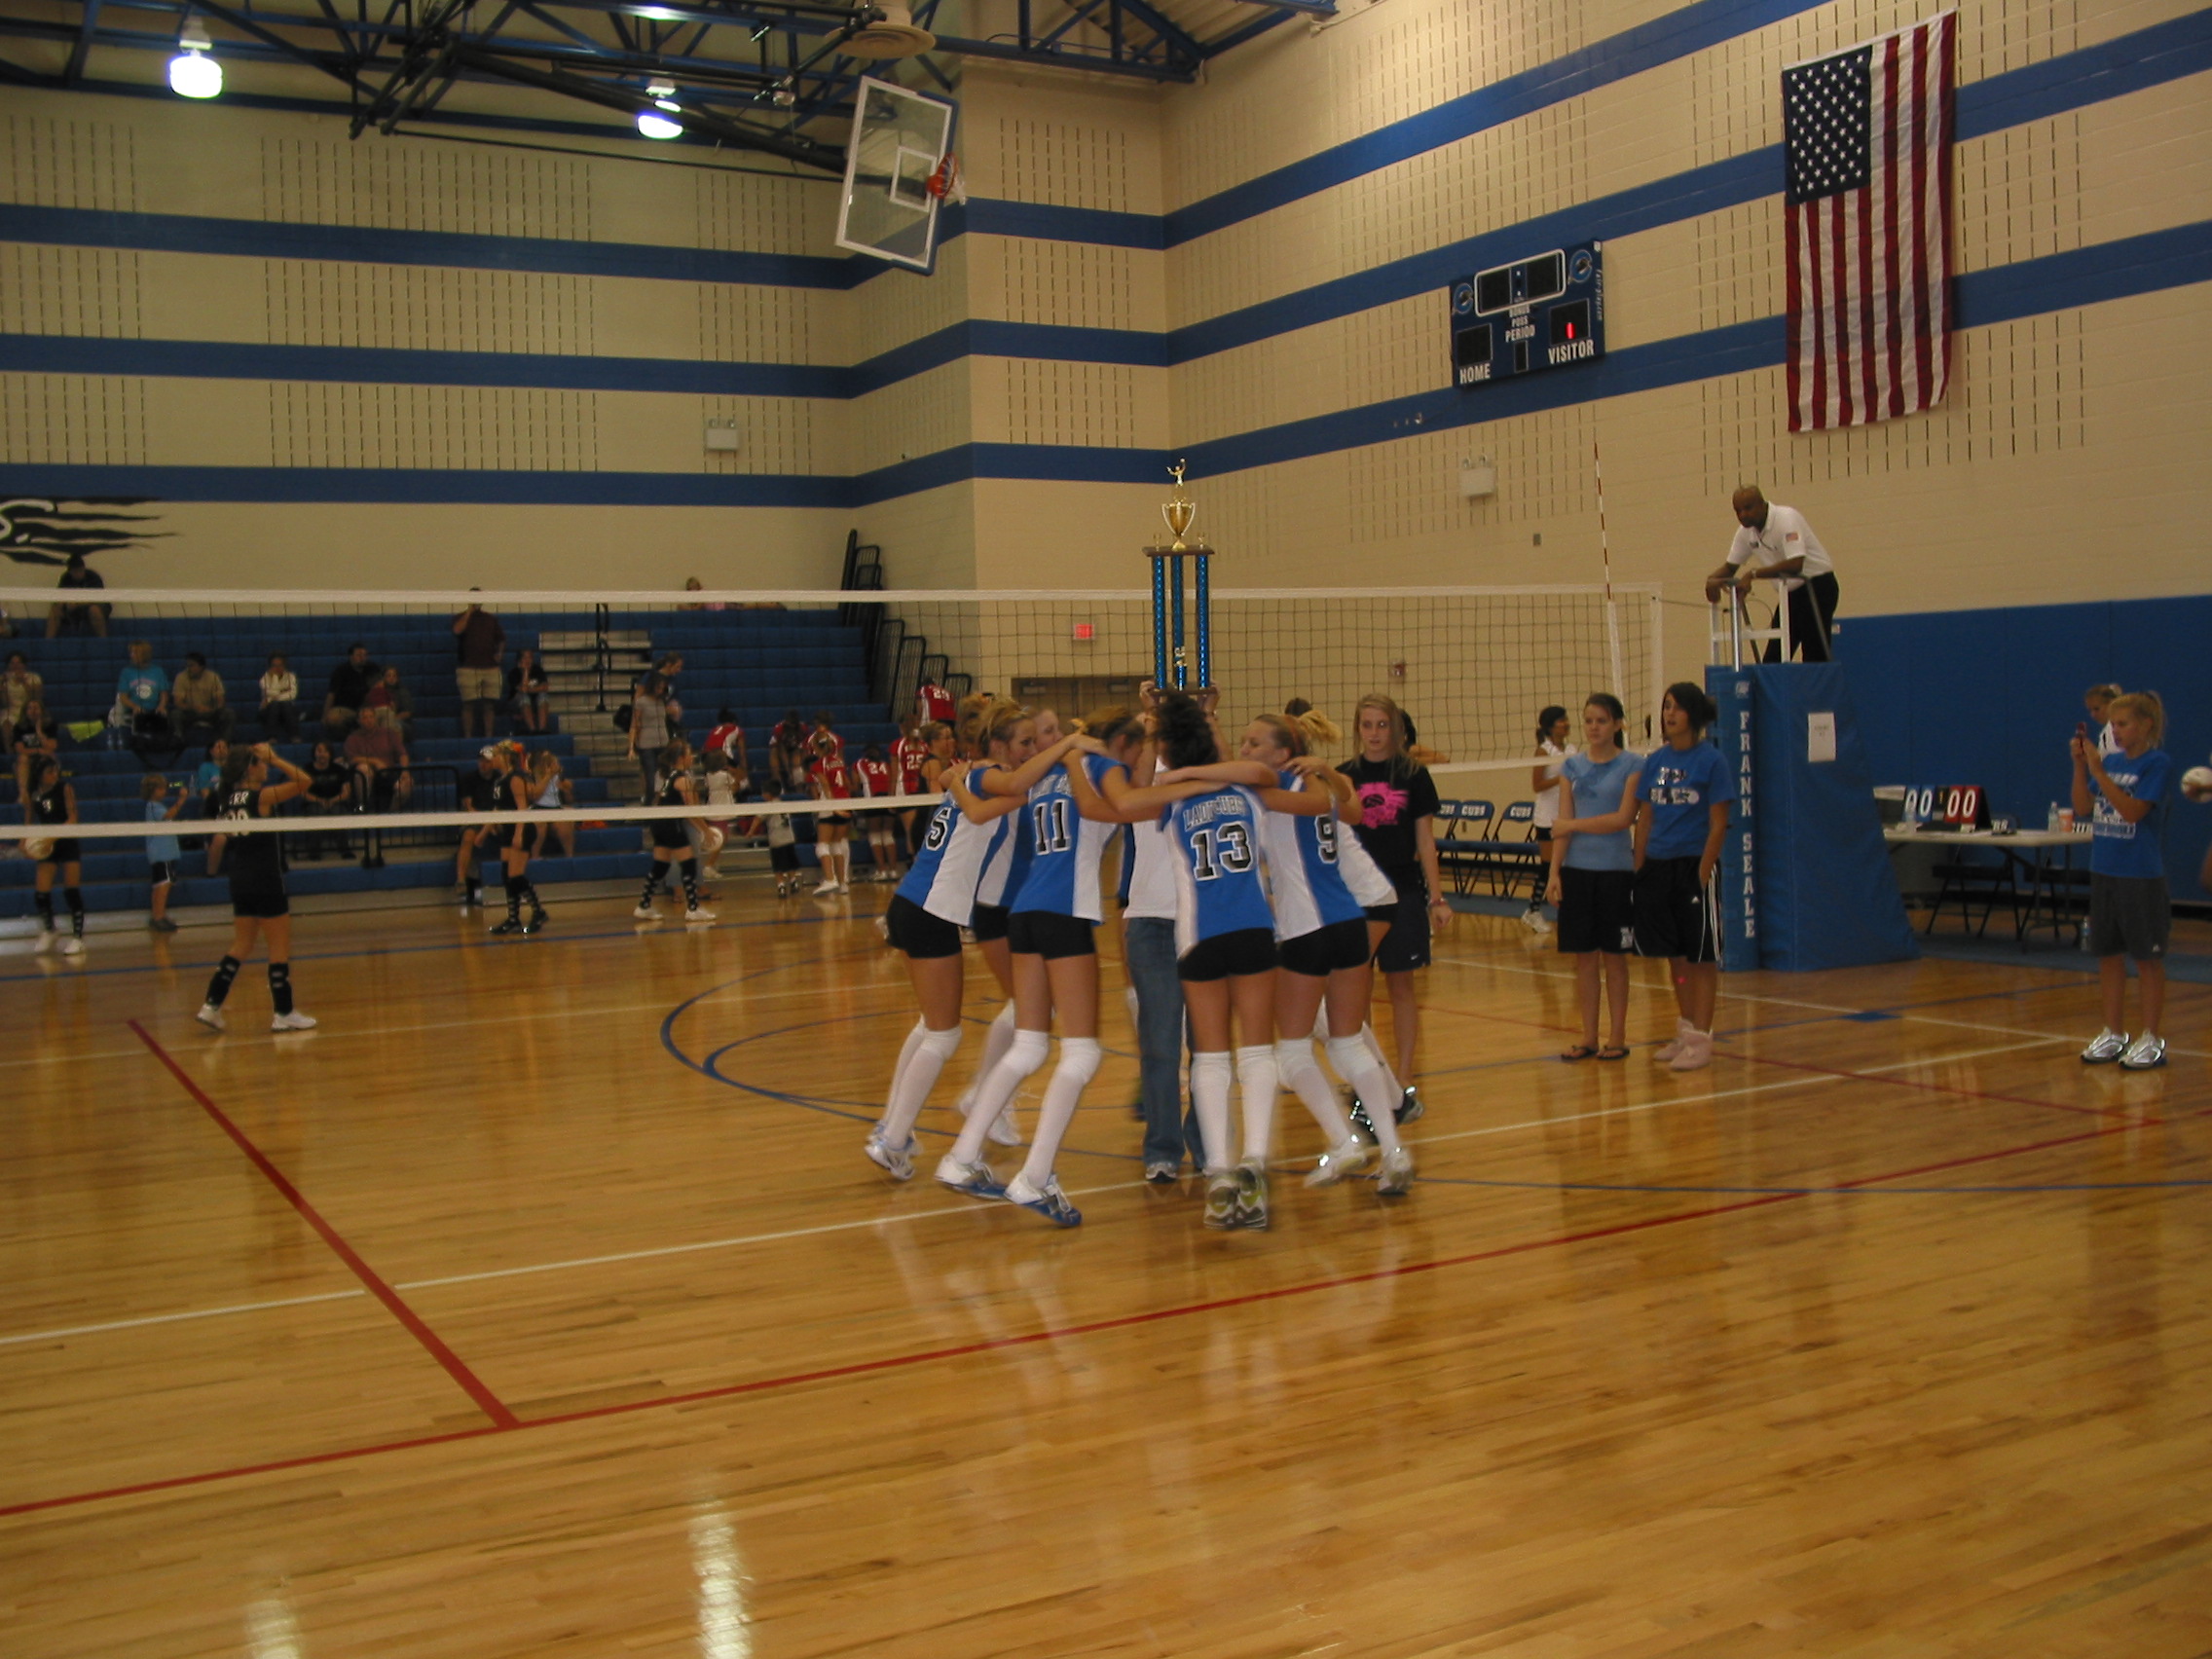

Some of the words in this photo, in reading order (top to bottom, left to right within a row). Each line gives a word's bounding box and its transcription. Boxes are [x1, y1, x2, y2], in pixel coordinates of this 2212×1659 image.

[1505, 324, 1535, 343] PERIOD
[1548, 339, 1595, 364] VISITOR
[1459, 363, 1491, 385] HOME
[867, 762, 887, 775] 24
[906, 754, 924, 770] 25
[1740, 712, 1751, 817] FRANK
[1461, 804, 1486, 817] CUBS
[1947, 789, 1976, 818] 00
[926, 807, 952, 851] 5
[1032, 798, 1071, 855] 11
[1314, 814, 1338, 864] 9
[1191, 821, 1253, 880] 13
[1743, 832, 1754, 938] SEALE
